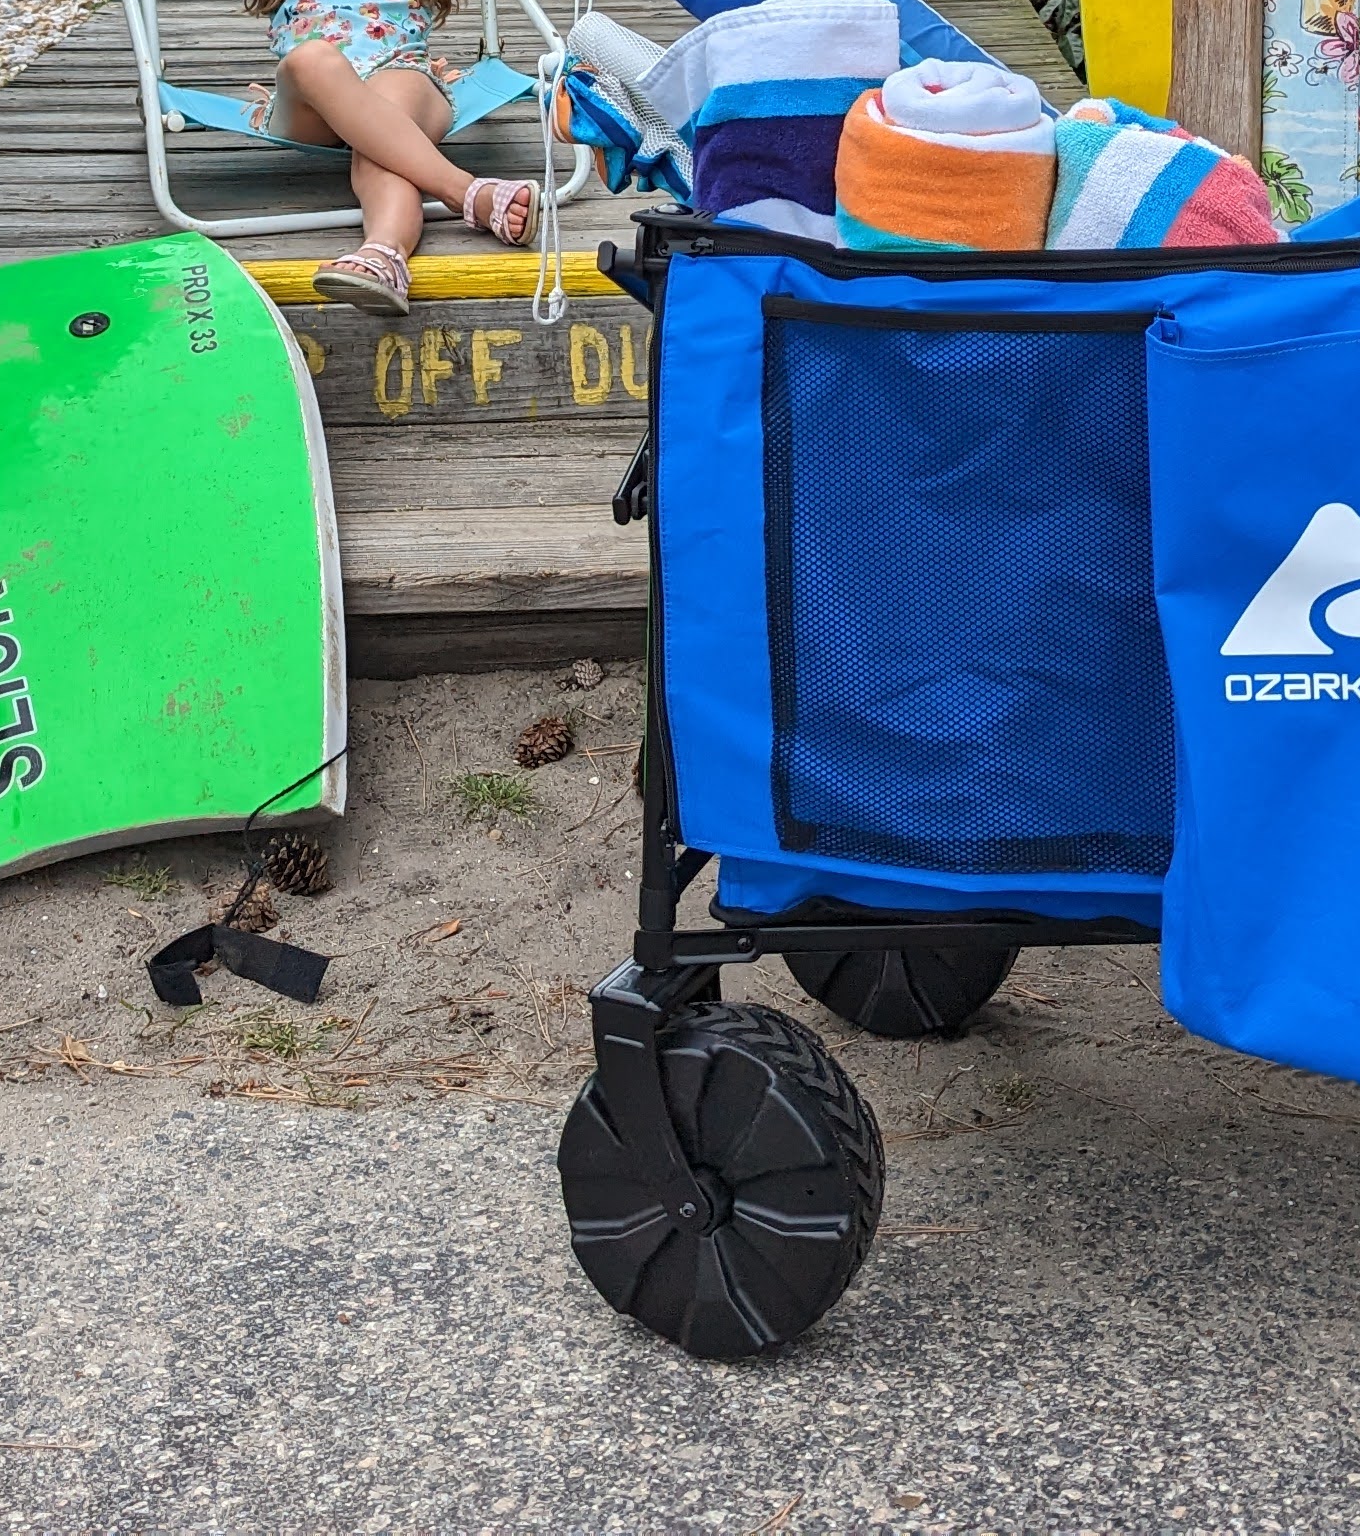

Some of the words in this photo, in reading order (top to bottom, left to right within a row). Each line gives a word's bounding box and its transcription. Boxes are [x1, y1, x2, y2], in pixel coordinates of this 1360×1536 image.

[181, 264, 211, 304] PRO
[187, 307, 214, 325] X
[189, 328, 218, 354] 33
[375, 326, 524, 419] OFF
